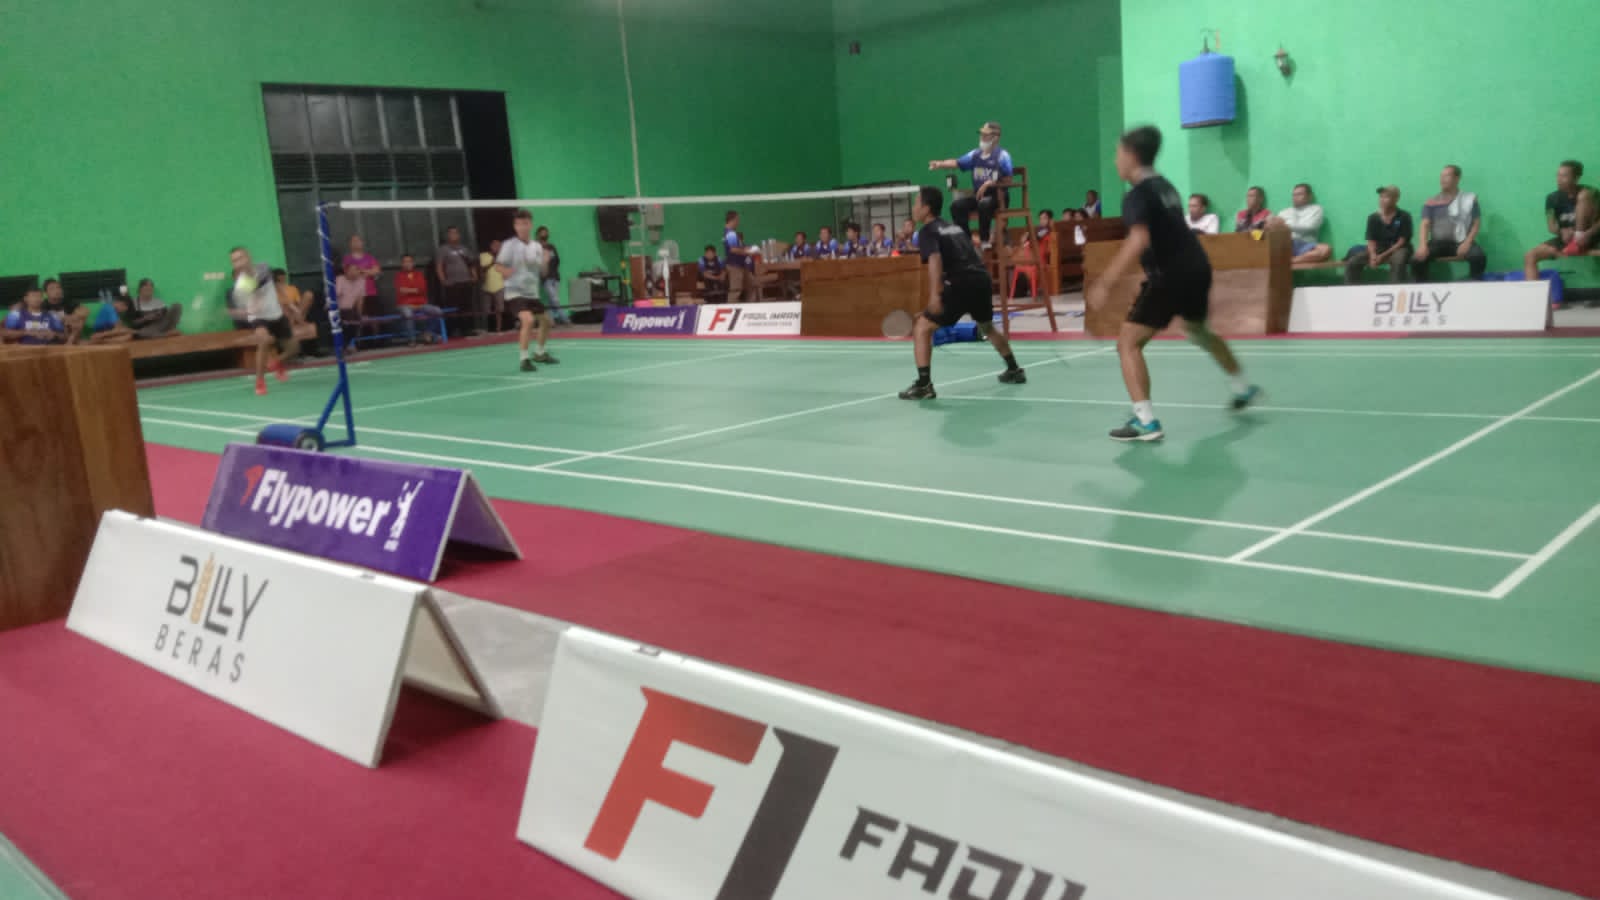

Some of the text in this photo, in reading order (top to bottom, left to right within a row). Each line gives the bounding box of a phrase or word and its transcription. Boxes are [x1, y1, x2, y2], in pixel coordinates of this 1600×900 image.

[622, 313, 678, 331] Flypower
[1373, 315, 1448, 327] BERAS
[1374, 288, 1452, 314] BILLY
[251, 469, 392, 536] Flypower
[166, 552, 270, 641] BILLY
[154, 623, 245, 683] BERAS
[583, 686, 840, 900] F1
